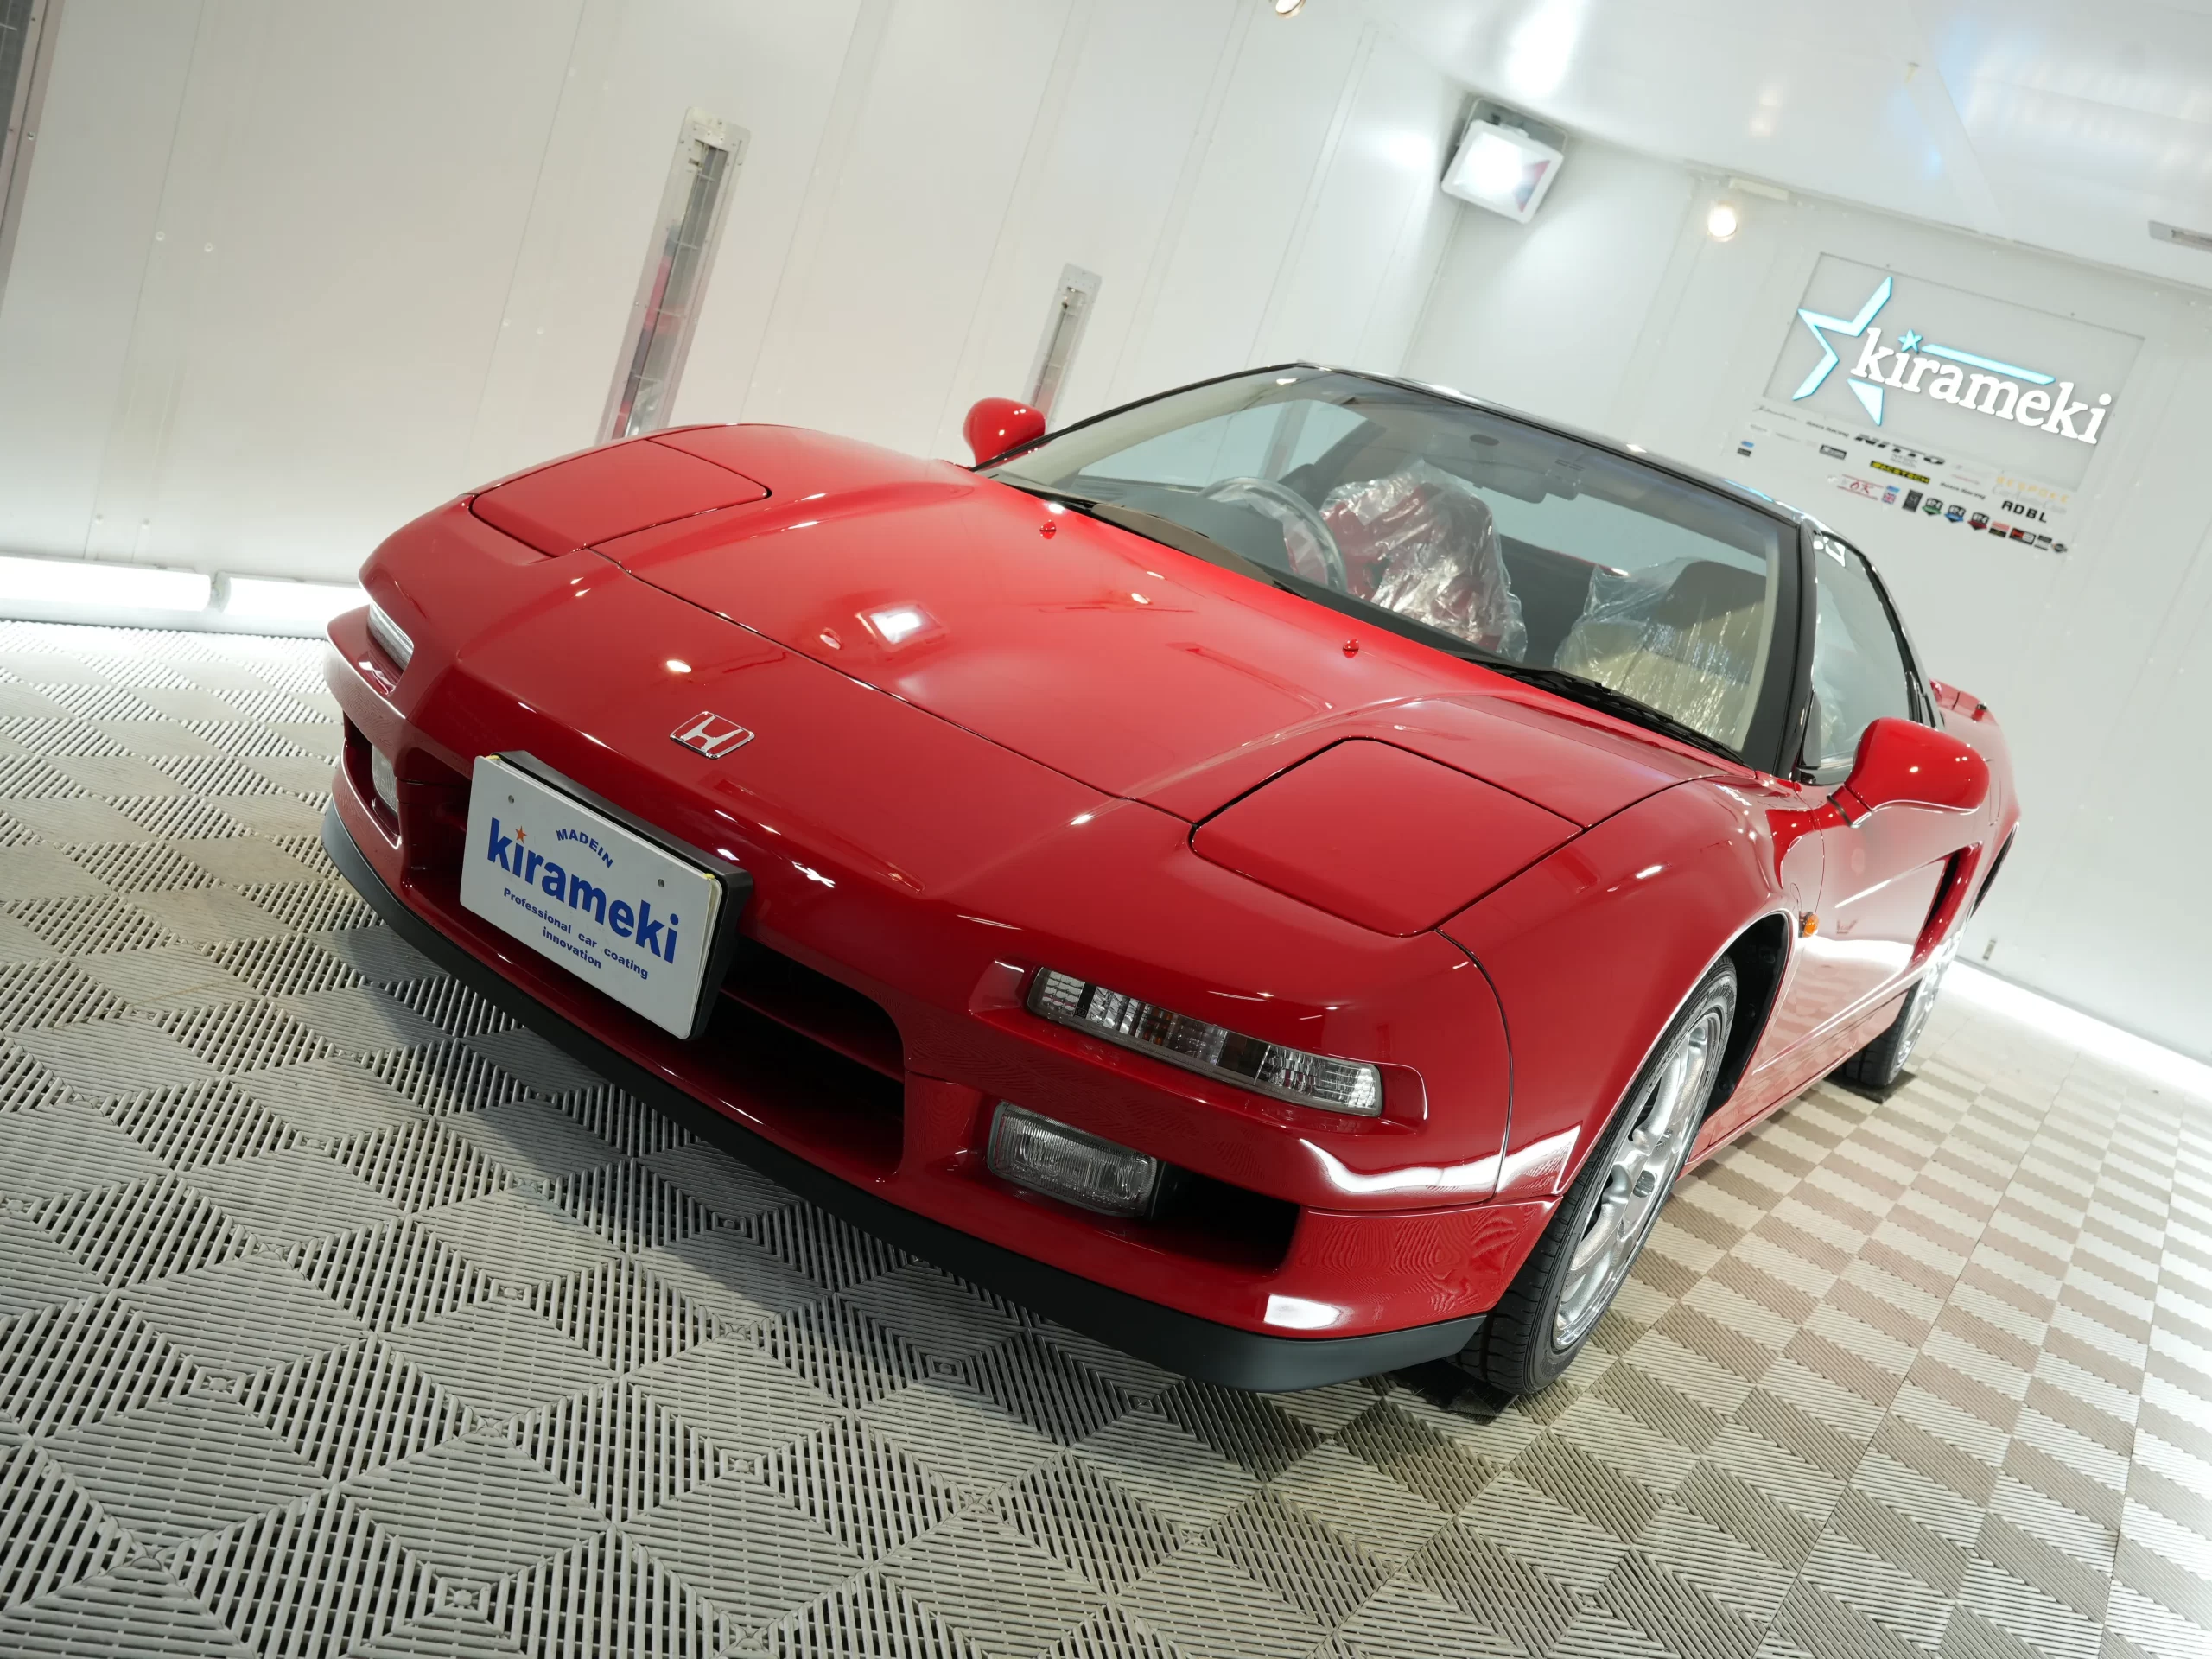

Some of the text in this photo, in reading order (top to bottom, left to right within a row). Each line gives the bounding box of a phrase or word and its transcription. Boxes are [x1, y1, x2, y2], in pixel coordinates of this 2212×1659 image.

[1850, 327, 2113, 445] kirameki
[1854, 433, 1946, 465] NITTO
[487, 817, 679, 964] kirameki
[503, 887, 649, 981] Professional car coating
[542, 925, 602, 969] innovation
